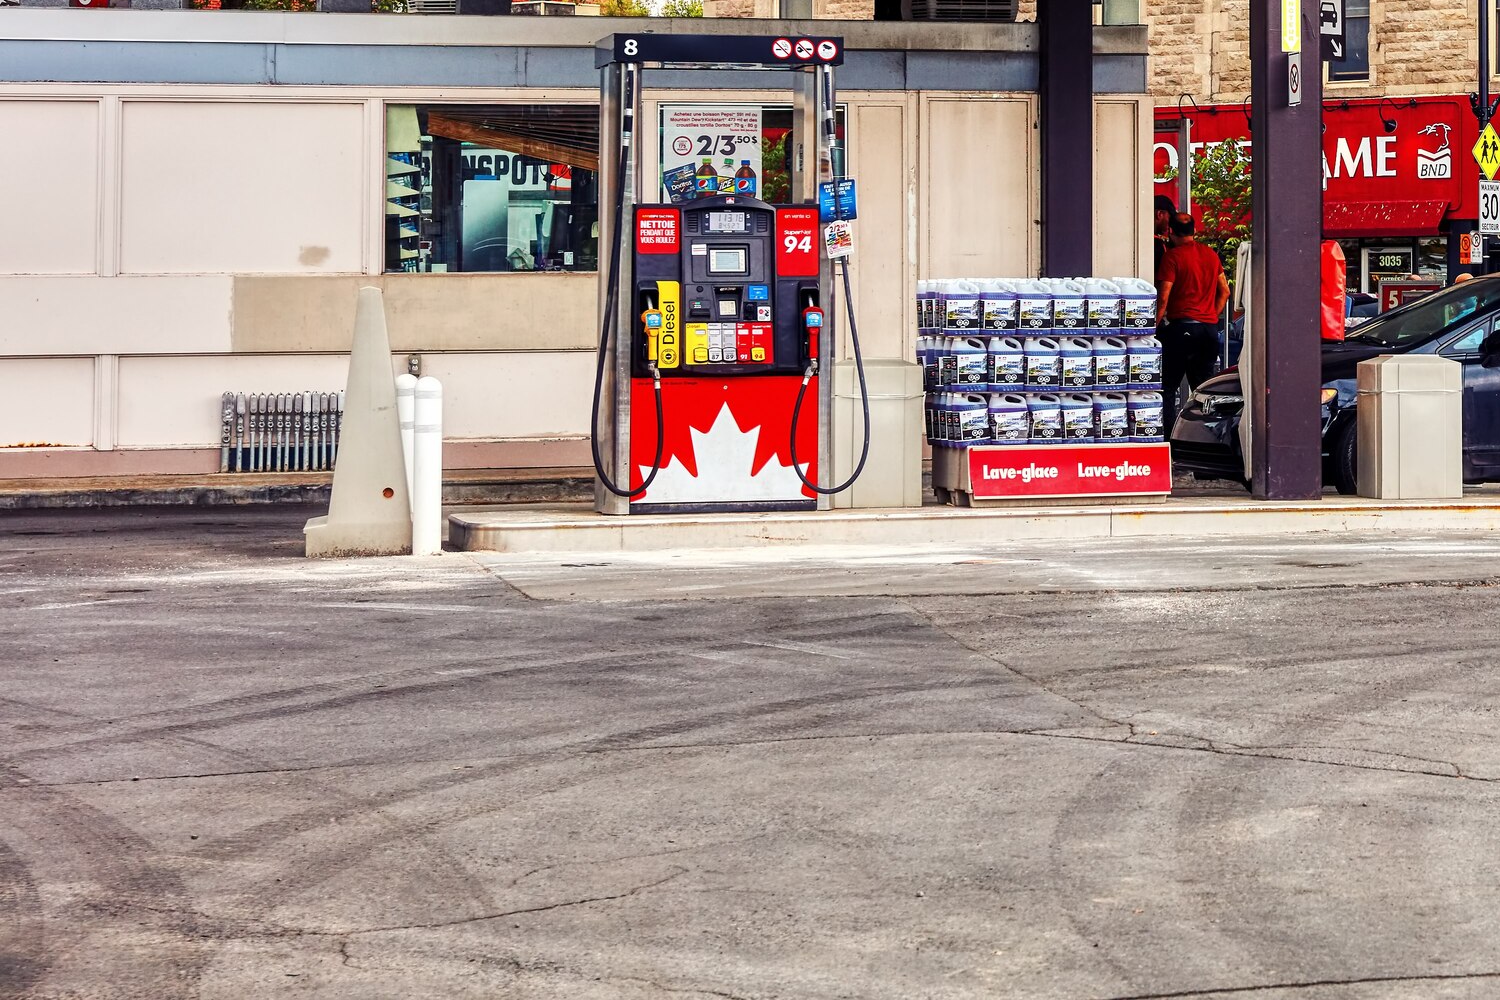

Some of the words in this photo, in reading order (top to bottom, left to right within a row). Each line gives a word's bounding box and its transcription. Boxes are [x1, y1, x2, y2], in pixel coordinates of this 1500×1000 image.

[624, 39, 638, 56] 8
[1421, 163, 1447, 176] BND
[1482, 193, 1498, 220] 30
[640, 220, 675, 228] NETTOIE
[784, 236, 811, 253] 94
[1379, 255, 1401, 266] 3035
[1389, 291, 1398, 309] 5
[663, 301, 674, 344] Diesel
[983, 463, 1058, 482] Lave-glace
[1078, 461, 1151, 480] Lave-glace
